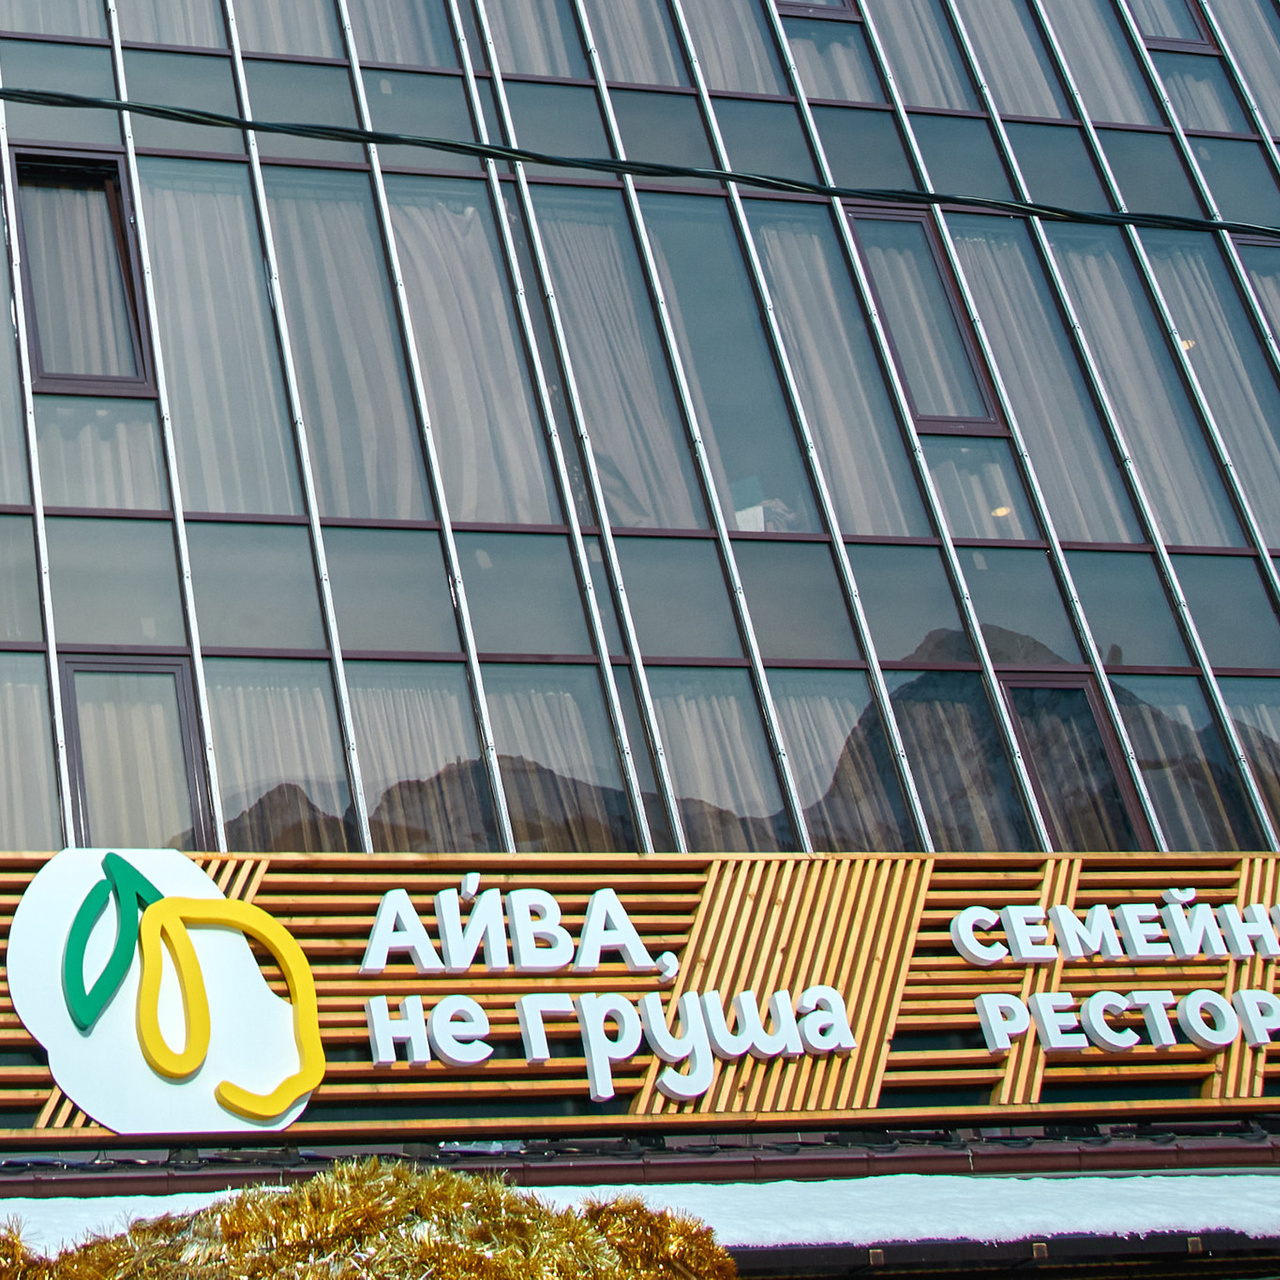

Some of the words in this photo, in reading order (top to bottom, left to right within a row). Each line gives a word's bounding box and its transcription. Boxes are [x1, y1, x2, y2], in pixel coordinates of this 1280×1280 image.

[359, 872, 680, 984] АЙВА,
[949, 888, 1280, 966] СЕМЕЙН
[364, 995, 494, 1067] не
[515, 985, 857, 1102] груша
